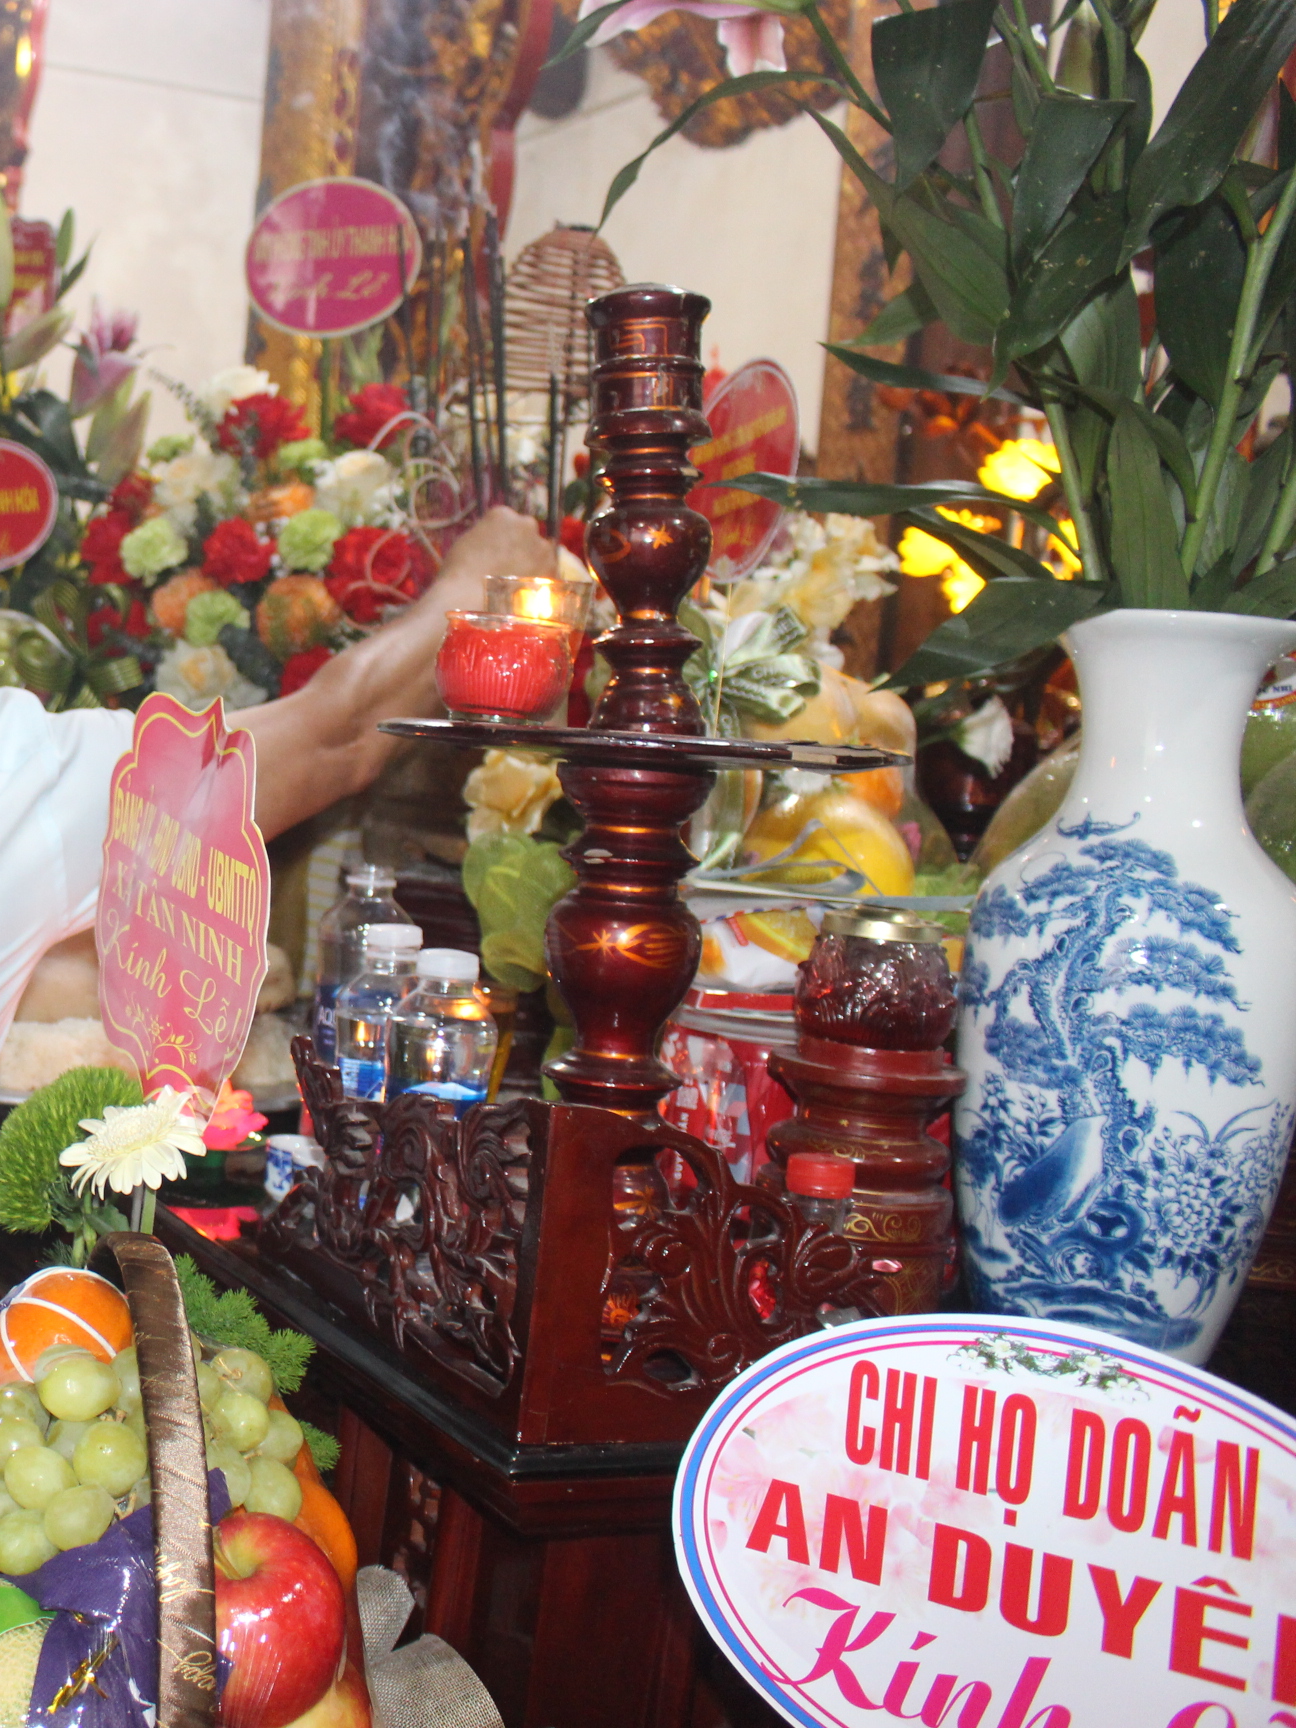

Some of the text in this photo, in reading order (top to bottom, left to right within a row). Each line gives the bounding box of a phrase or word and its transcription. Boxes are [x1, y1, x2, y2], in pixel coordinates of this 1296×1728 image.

[135, 878, 176, 939] TÂN
[181, 909, 245, 987] NINH
[207, 846, 256, 947] UBMTTQ
[104, 908, 172, 998] Kính
[845, 1359, 1261, 1562] CHI HỌ DOÃN
[745, 1478, 889, 1587] AN
[760, 1587, 1071, 1728] Kính
